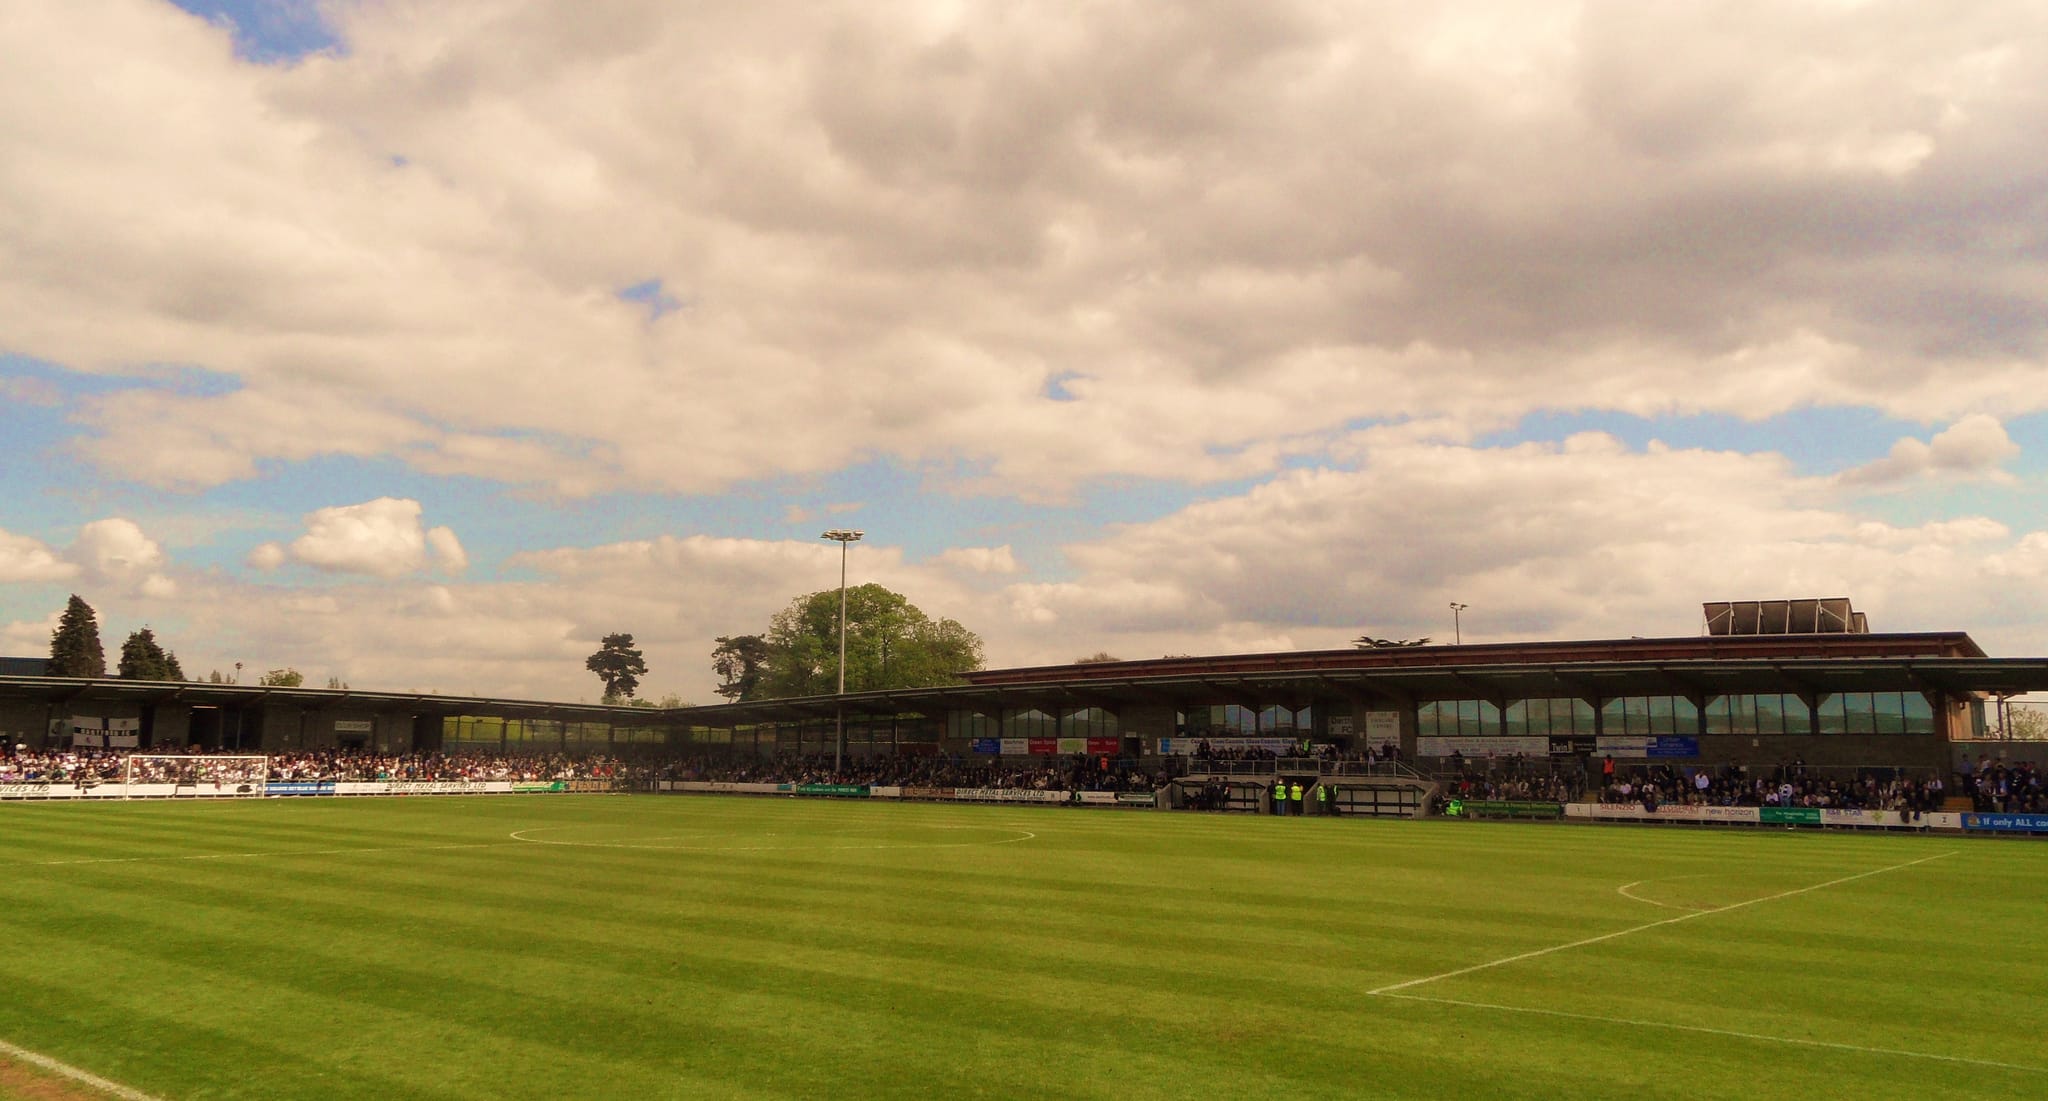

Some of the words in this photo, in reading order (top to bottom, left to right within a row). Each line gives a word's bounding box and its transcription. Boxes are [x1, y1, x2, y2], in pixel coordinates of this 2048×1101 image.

[1983, 817, 1990, 825] If
[1993, 818, 2012, 828] only
[2015, 818, 2032, 827] ALL
